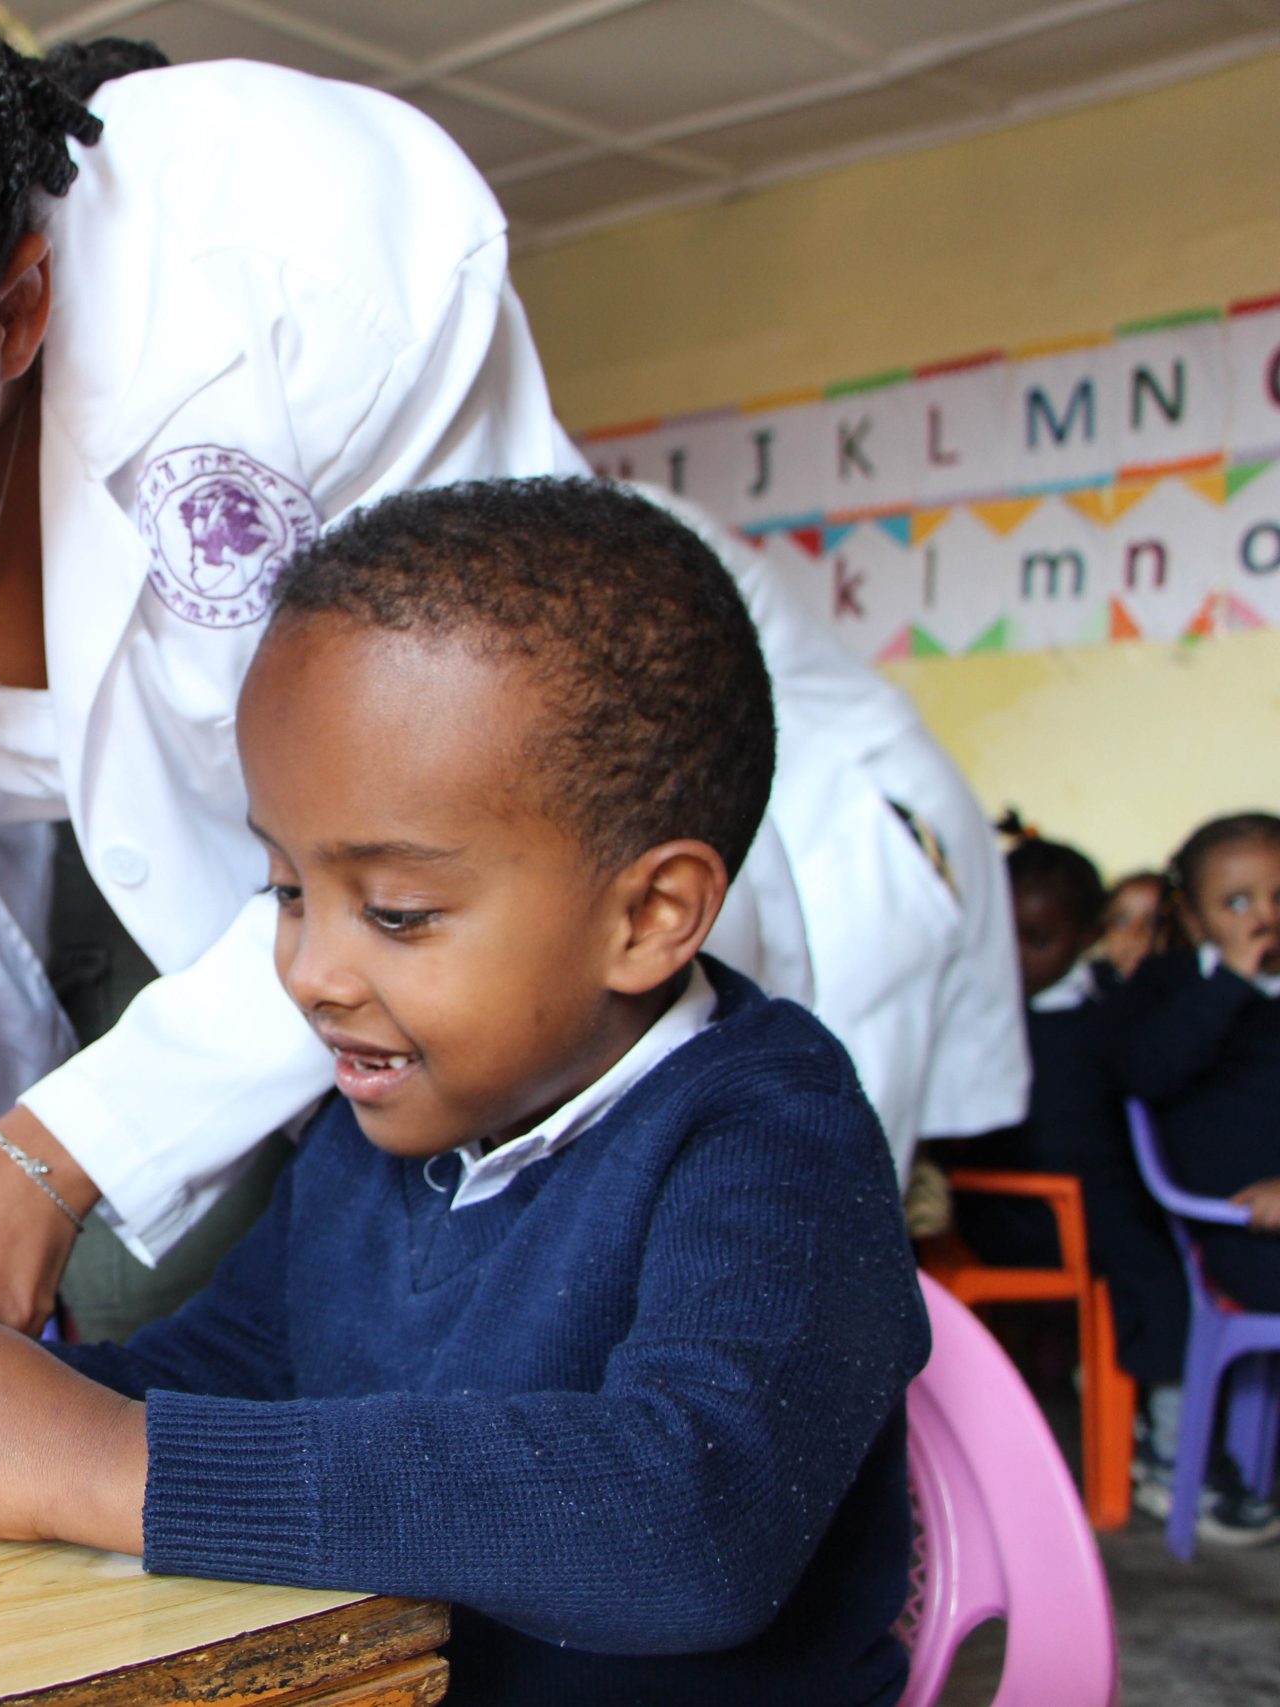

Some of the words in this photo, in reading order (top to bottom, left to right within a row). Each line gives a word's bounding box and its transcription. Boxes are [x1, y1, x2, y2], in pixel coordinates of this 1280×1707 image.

[749, 428, 776, 497] J
[836, 416, 874, 478] K
[926, 402, 957, 466] L
[1026, 376, 1096, 449] M
[1131, 356, 1185, 430] N
[833, 553, 865, 618] k
[1022, 549, 1086, 598] m
[1125, 538, 1168, 588] n
[1239, 521, 1280, 575] o
